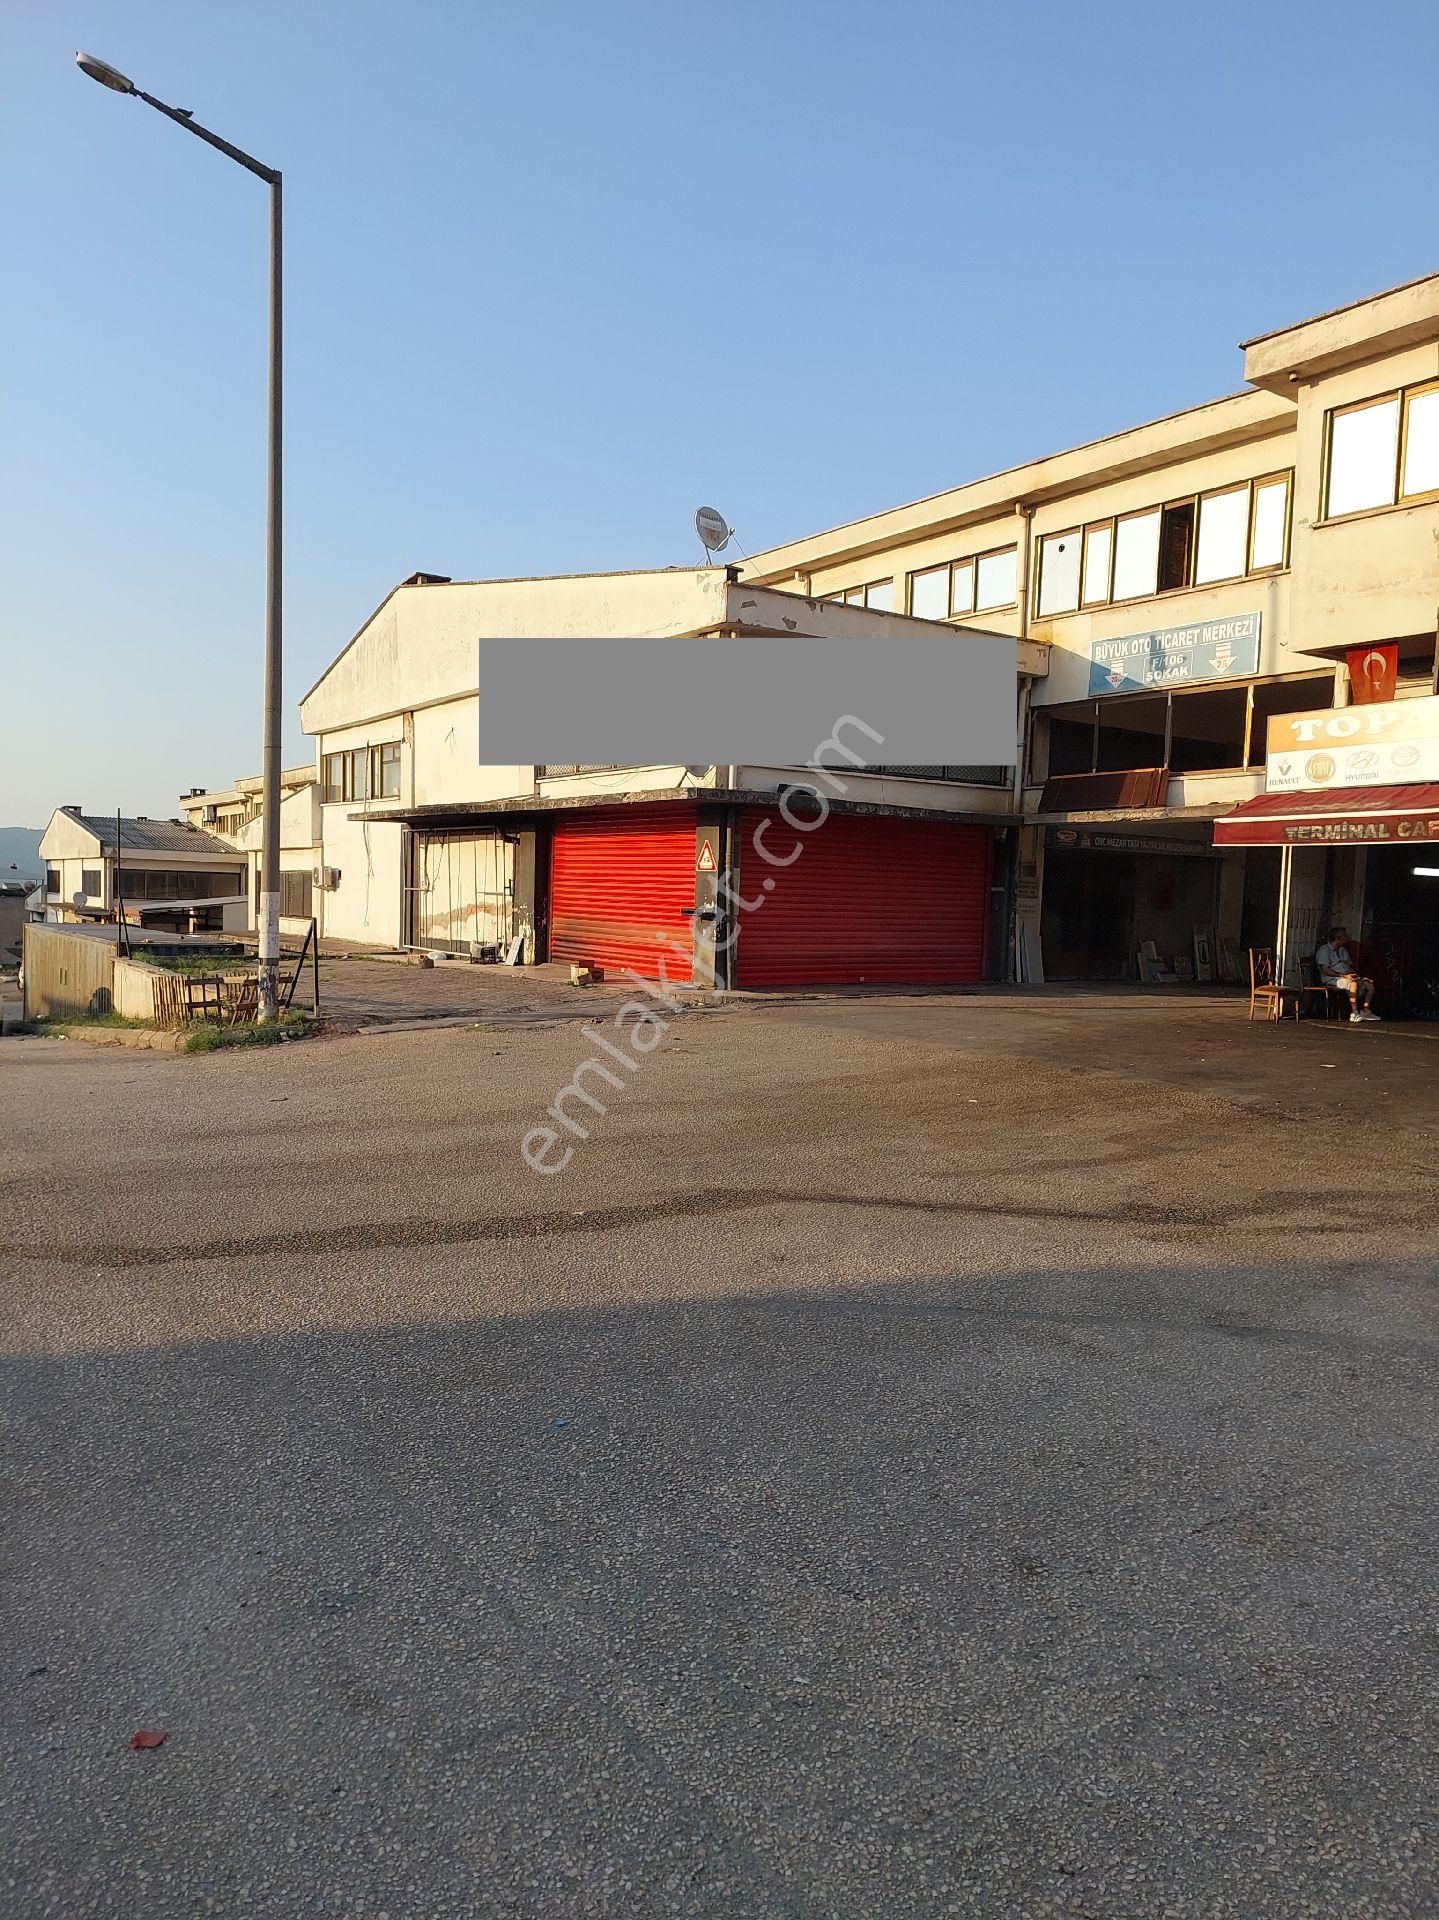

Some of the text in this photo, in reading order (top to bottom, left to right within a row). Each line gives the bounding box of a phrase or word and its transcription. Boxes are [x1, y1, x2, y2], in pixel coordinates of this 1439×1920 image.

[1095, 615, 1254, 661] BÜYÜK OTO TİCARET MERKEZİ
[1152, 653, 1184, 668] F/106
[1145, 665, 1189, 681] SOKAK
[1312, 761, 1331, 776] FIAT
[1269, 777, 1301, 786] RENAULT
[1345, 772, 1379, 781] HYUNDAI
